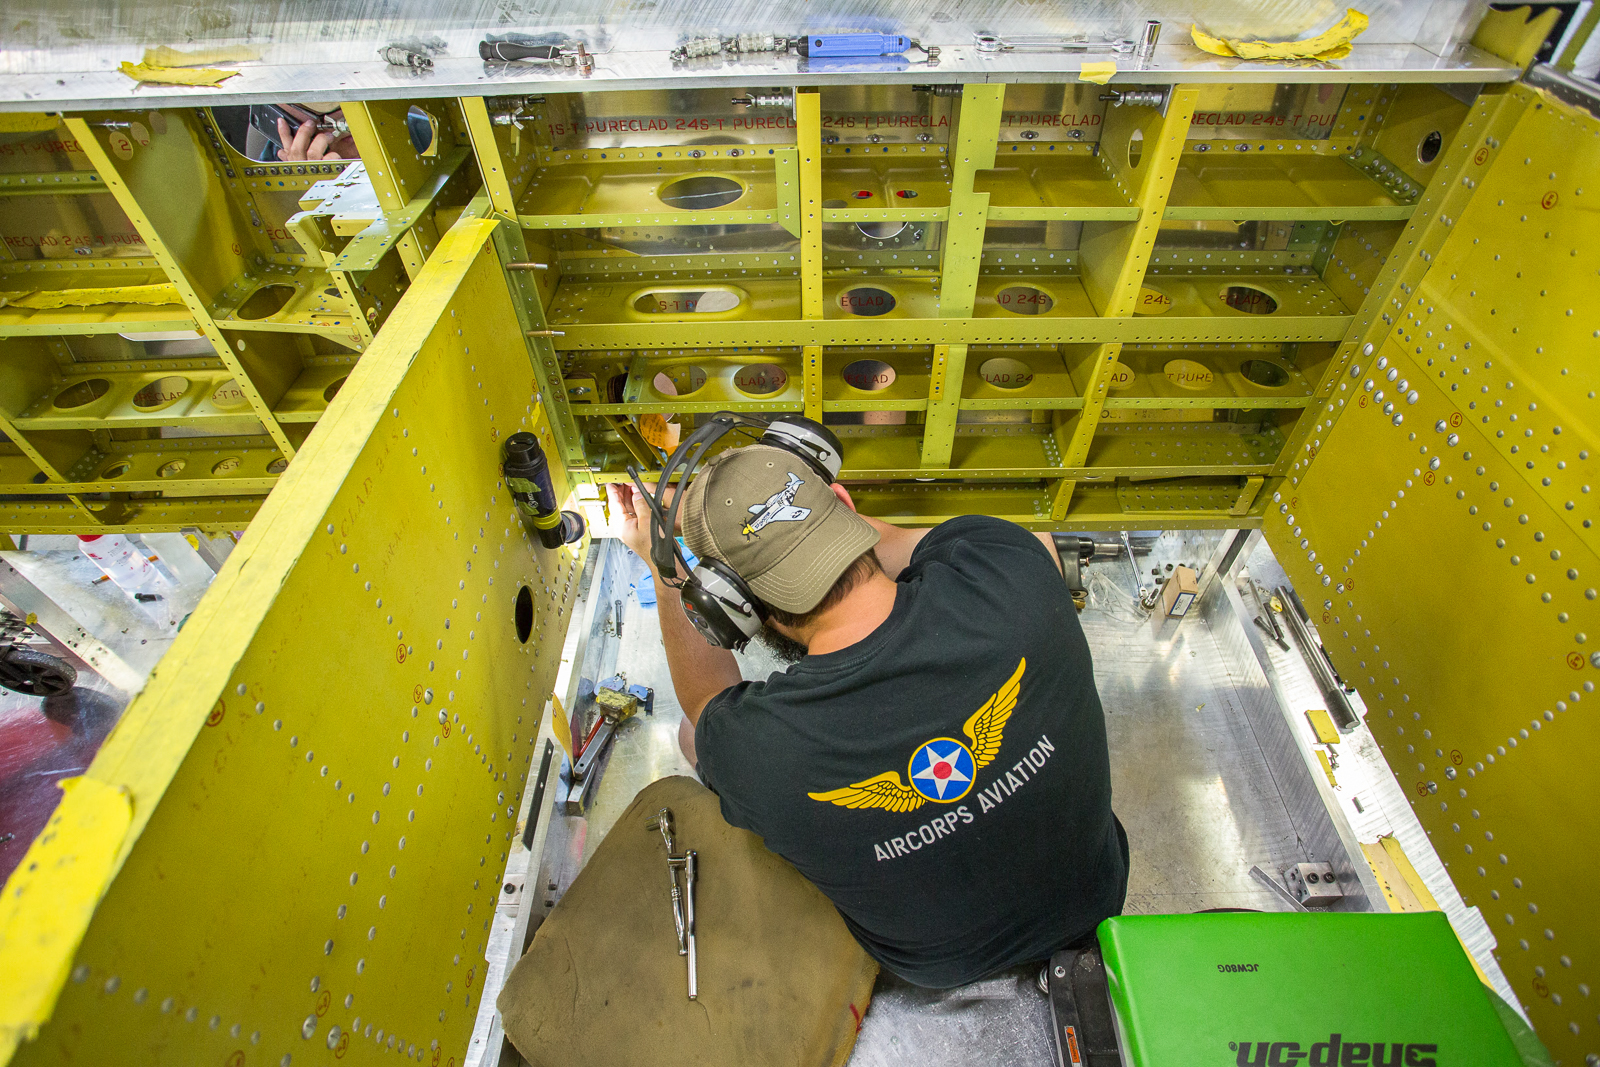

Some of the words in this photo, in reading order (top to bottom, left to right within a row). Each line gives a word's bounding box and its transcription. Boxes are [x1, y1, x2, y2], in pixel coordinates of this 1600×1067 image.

[585, 118, 668, 134] PURECLAD
[676, 118, 725, 131] 24S-T
[733, 116, 797, 130] PURECL
[1019, 114, 1101, 127] PURECLAD
[1252, 114, 1302, 126] 24S-T
[873, 805, 975, 862] AIRCORPS
[976, 734, 1056, 814] AVIATION
[1217, 963, 1260, 974] JCW80G
[1236, 1033, 1438, 1067] snap-on
